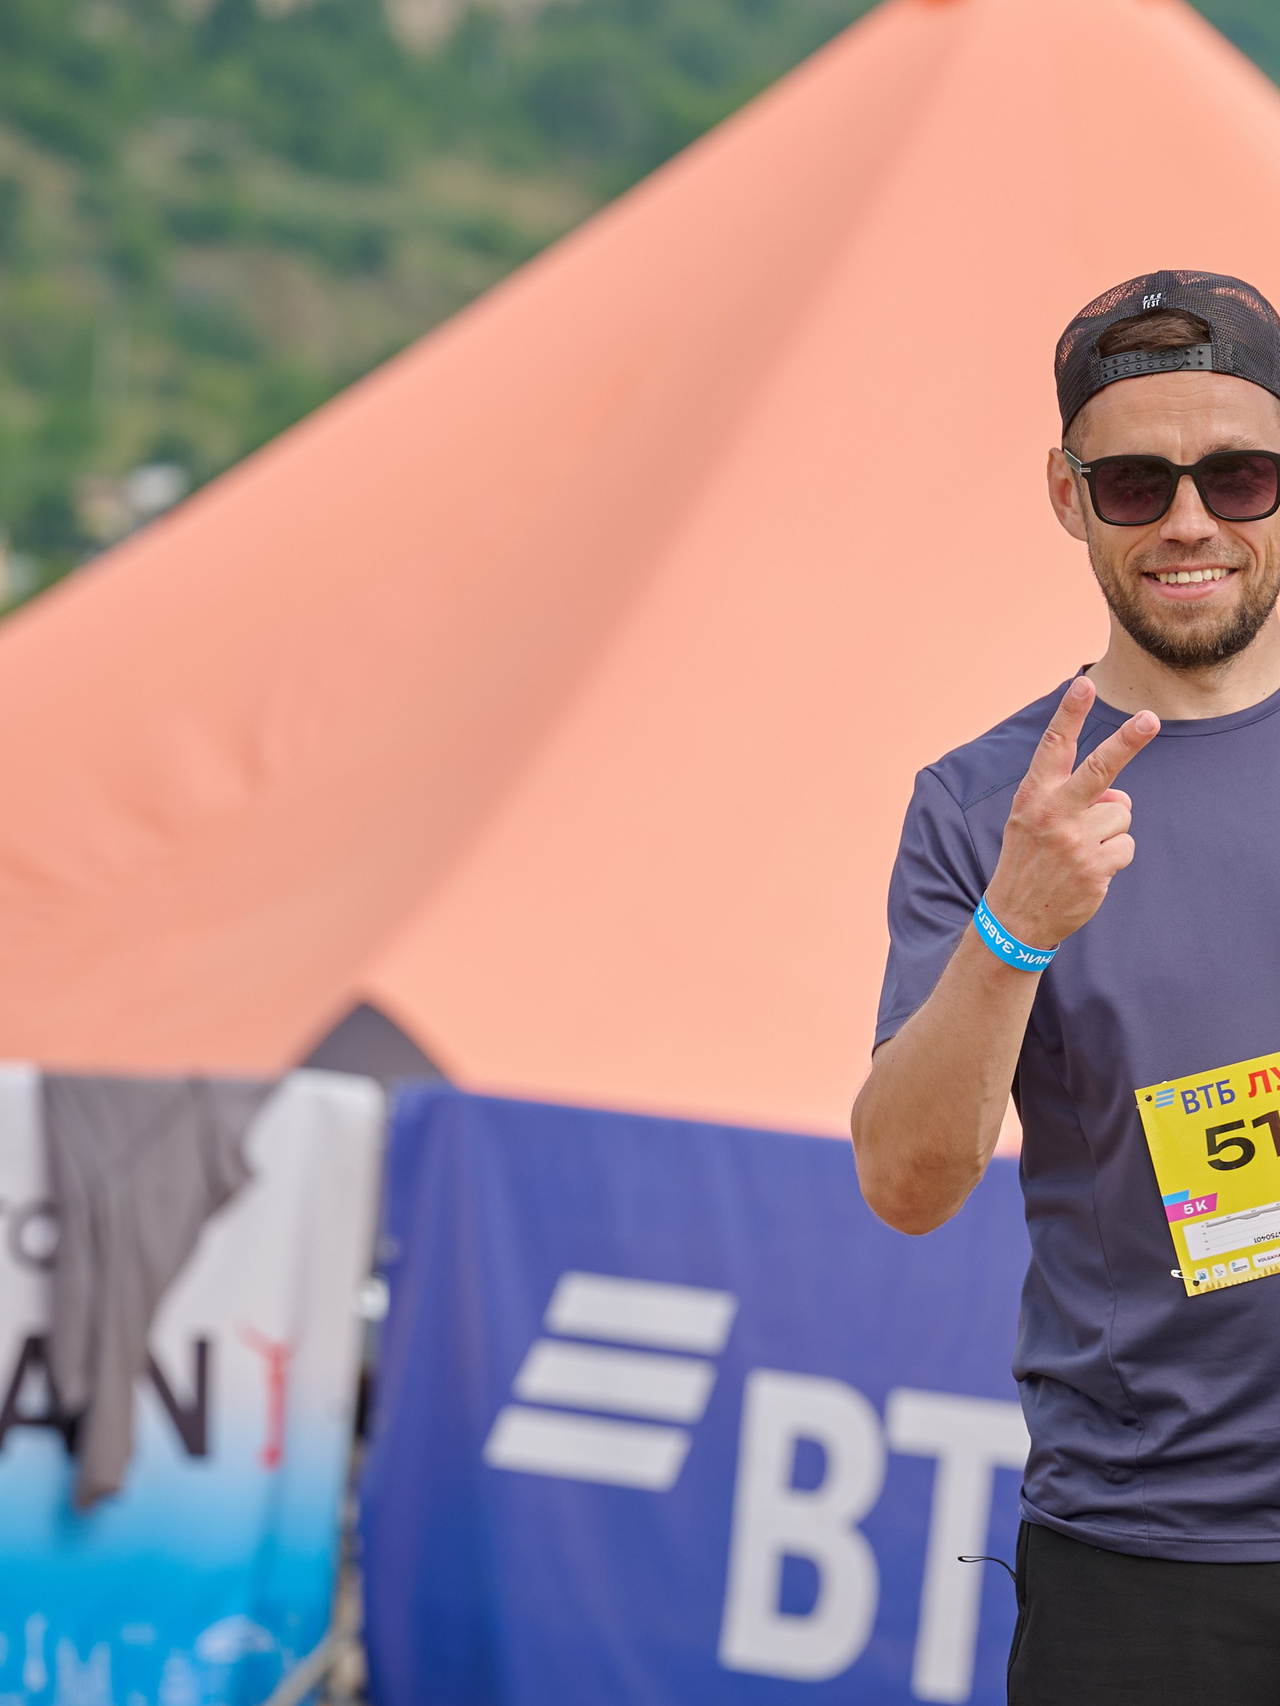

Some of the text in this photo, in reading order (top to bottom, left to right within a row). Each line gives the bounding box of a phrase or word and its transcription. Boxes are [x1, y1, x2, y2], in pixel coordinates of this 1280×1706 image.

[1142, 299, 1160, 310] TEST
[1015, 949, 1053, 965] НИК
[1180, 1079, 1236, 1115] ВТБ
